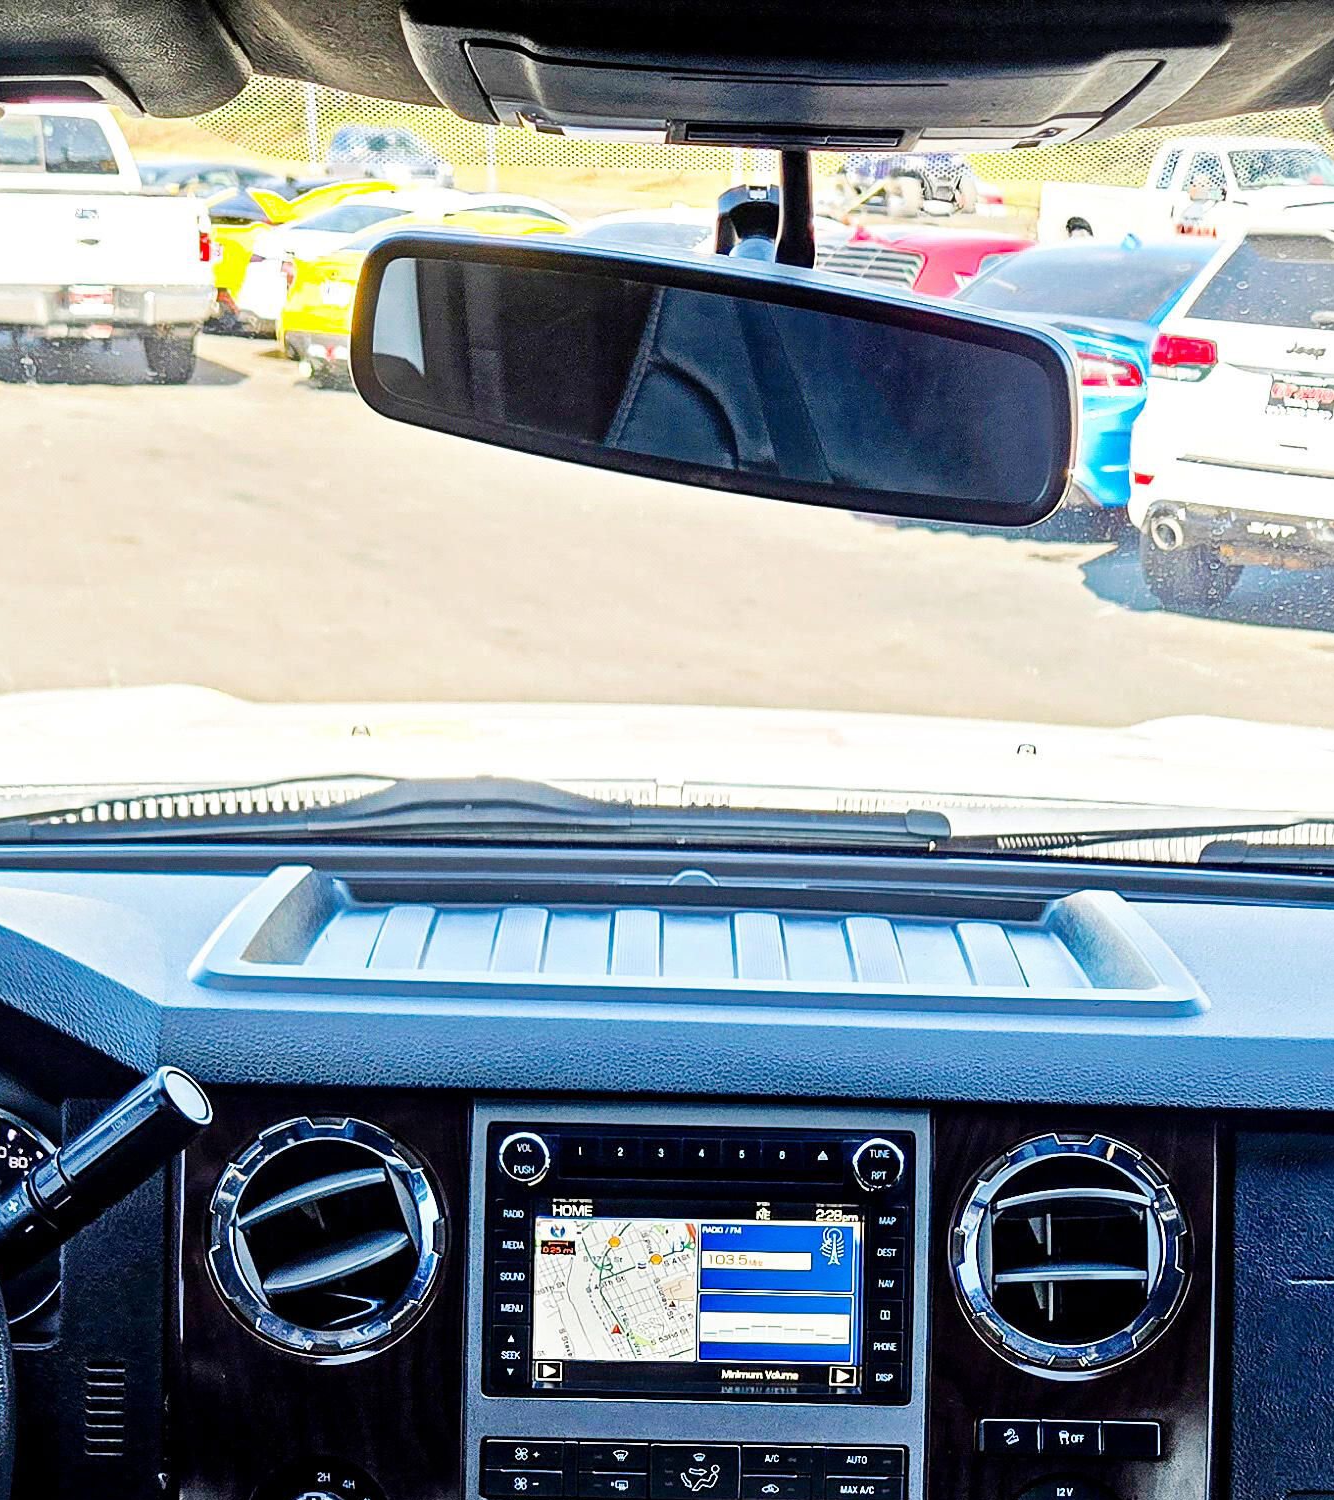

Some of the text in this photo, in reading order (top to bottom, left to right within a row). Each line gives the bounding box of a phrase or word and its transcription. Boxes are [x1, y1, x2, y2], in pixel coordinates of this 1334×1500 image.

[1286, 342, 1326, 360] Jeep
[517, 1144, 532, 1153] VOL
[617, 1147, 624, 1156] 2
[658, 1148, 664, 1157] 3
[699, 1149, 705, 1158] 4
[739, 1150, 745, 1159] 5
[870, 1149, 889, 1158] TUNE
[9, 1157, 28, 1169] 80
[514, 1165, 534, 1174] PUSH
[871, 1171, 886, 1180] RPT
[503, 1209, 524, 1219] RADIO
[553, 1205, 593, 1217] HOME
[879, 1216, 896, 1225] MAP
[702, 1226, 723, 1234] RADIO
[730, 1227, 742, 1235] FM
[502, 1240, 524, 1250] MEDIA
[877, 1248, 896, 1257] DEST
[500, 1272, 525, 1281] SOUND
[878, 1279, 894, 1289] NAV
[501, 1304, 523, 1313] MENU
[873, 1342, 897, 1351] PHONE
[501, 1351, 520, 1360] SEEK
[722, 1370, 799, 1381] Minimum Volume
[876, 1373, 893, 1382] DISP
[1071, 1434, 1085, 1443] OFF
[764, 1454, 779, 1464] A/C
[846, 1455, 868, 1465] AUTO
[317, 1472, 331, 1482] 2H
[342, 1480, 355, 1489] 4H
[840, 1485, 875, 1495] MAX A/C
[1056, 1488, 1073, 1497] 12V
